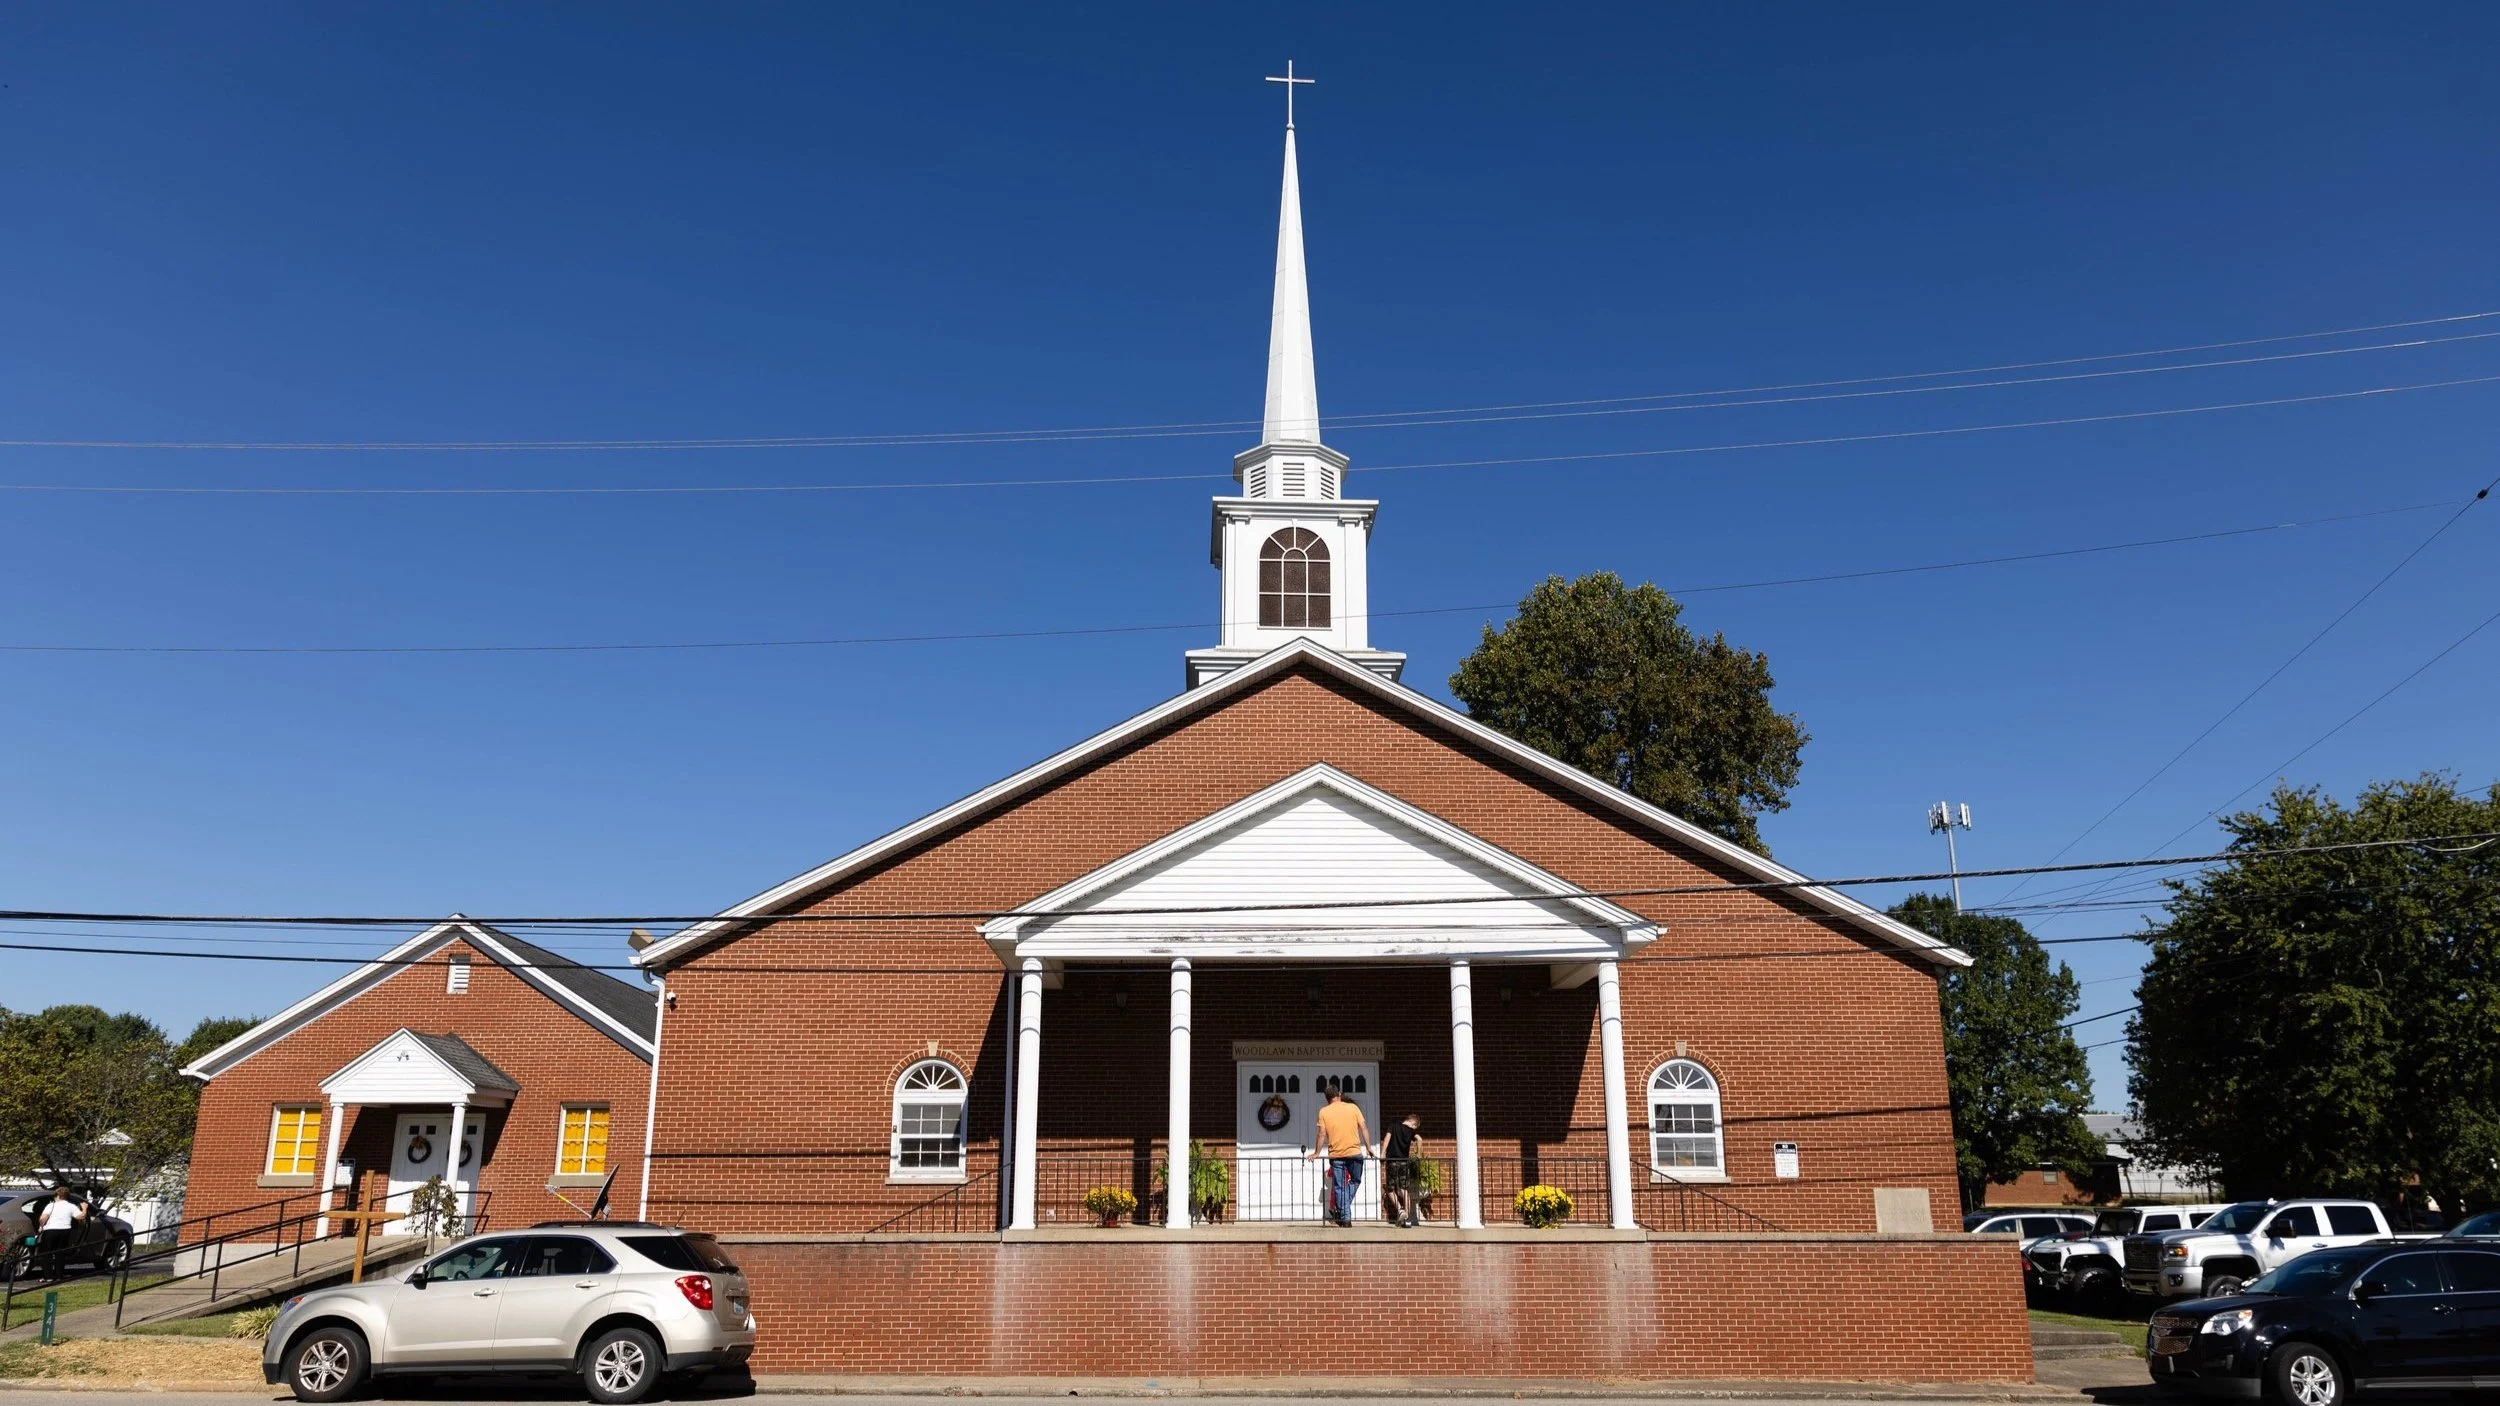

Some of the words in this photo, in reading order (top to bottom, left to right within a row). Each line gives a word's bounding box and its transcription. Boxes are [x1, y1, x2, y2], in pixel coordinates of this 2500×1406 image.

[1234, 1046, 1294, 1056] WOODLAWN
[1297, 1046, 1337, 1056] BAPTIST
[1338, 1046, 1383, 1057] CHURCH
[46, 1302, 54, 1338] 341
